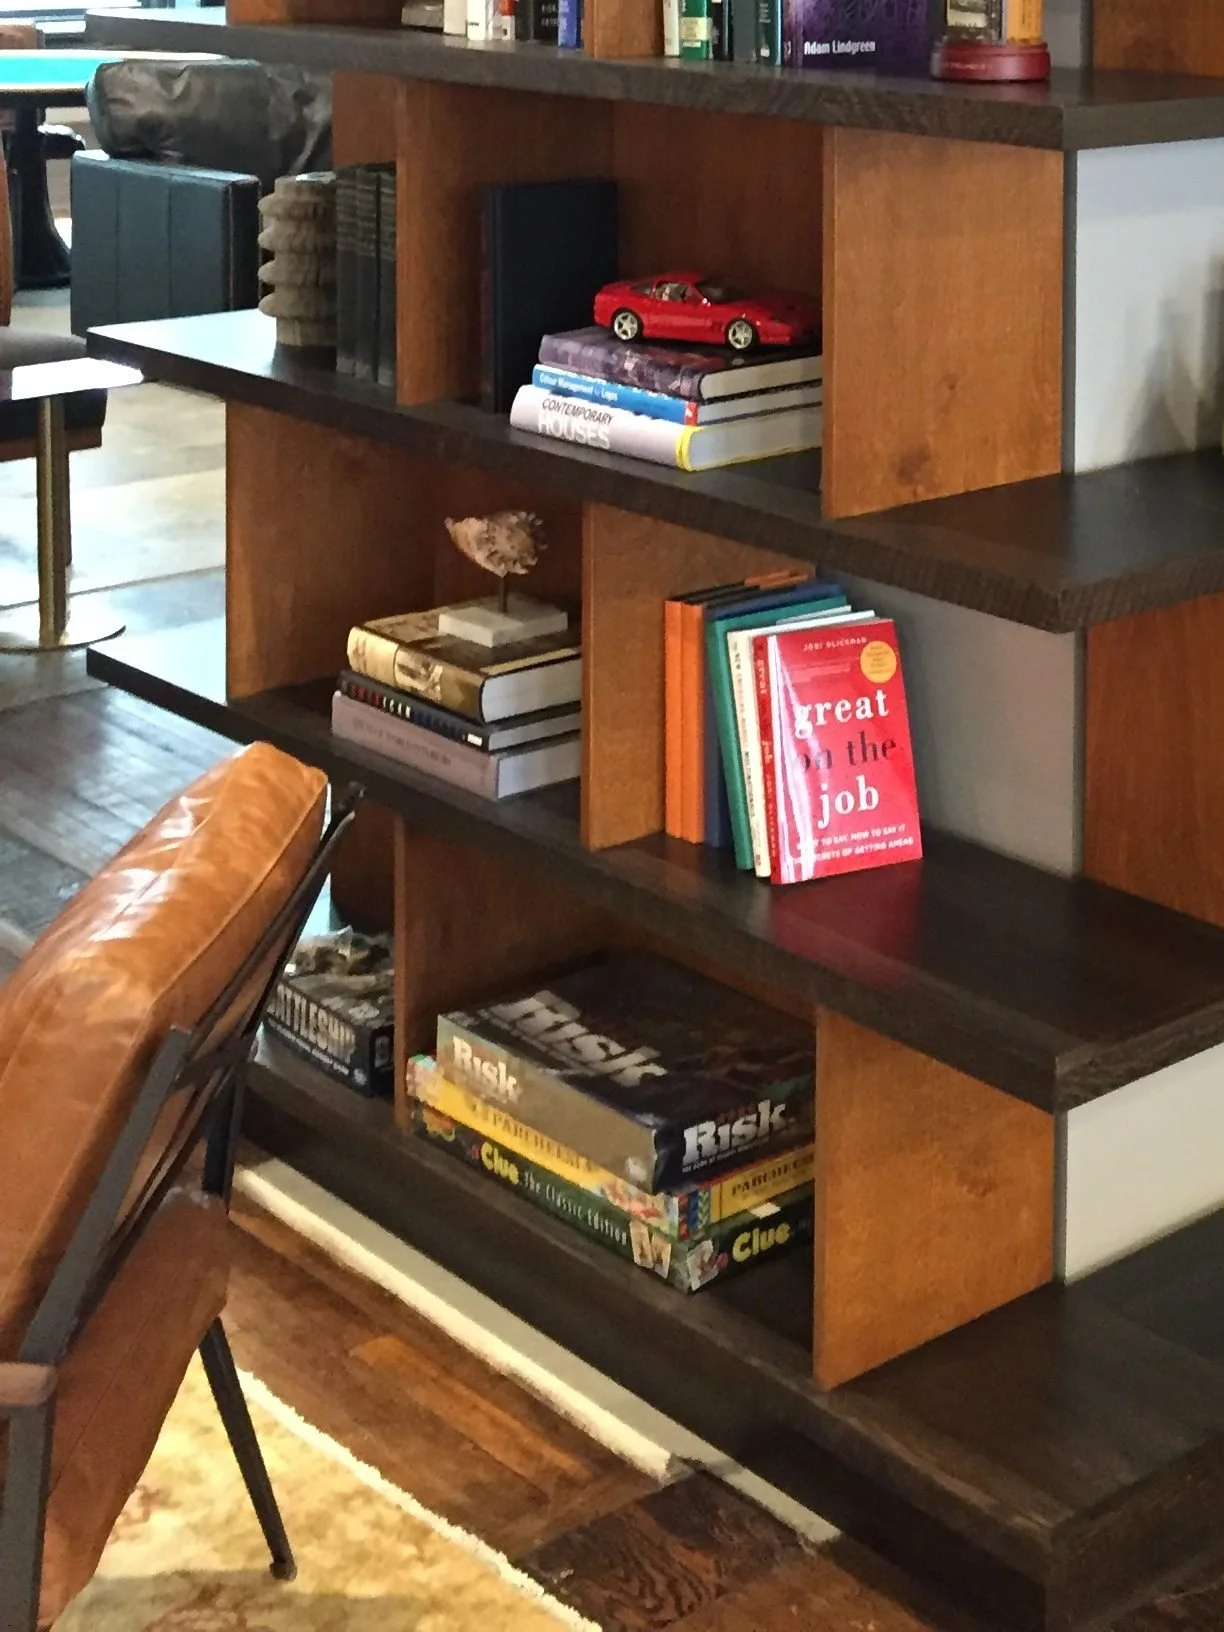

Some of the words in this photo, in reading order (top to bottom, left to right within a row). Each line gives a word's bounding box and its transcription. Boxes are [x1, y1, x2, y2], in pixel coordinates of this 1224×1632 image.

[804, 41, 830, 55] Adam
[832, 40, 876, 54] Lindgreen
[558, 376, 593, 394] Management
[537, 411, 611, 450] HOUSES
[542, 398, 614, 426] CONTEMPORARY
[794, 689, 889, 739] great
[846, 730, 897, 766] the
[817, 775, 880, 829] job
[822, 834, 832, 847] TO
[851, 829, 869, 842] HOW
[871, 827, 881, 839] TO
[883, 825, 898, 837] SAY
[899, 823, 906, 833] IT
[842, 846, 853, 857] OF
[854, 841, 887, 856] GETTING
[888, 837, 914, 850] AHEAD
[490, 990, 669, 1088] Risk
[452, 1035, 520, 1101] Risk
[683, 1099, 786, 1167] Risk
[481, 1140, 519, 1185] Clue
[523, 1171, 540, 1195] The
[545, 1182, 583, 1219] Classic
[587, 1208, 628, 1246] Edition
[732, 1222, 791, 1263] Clue
